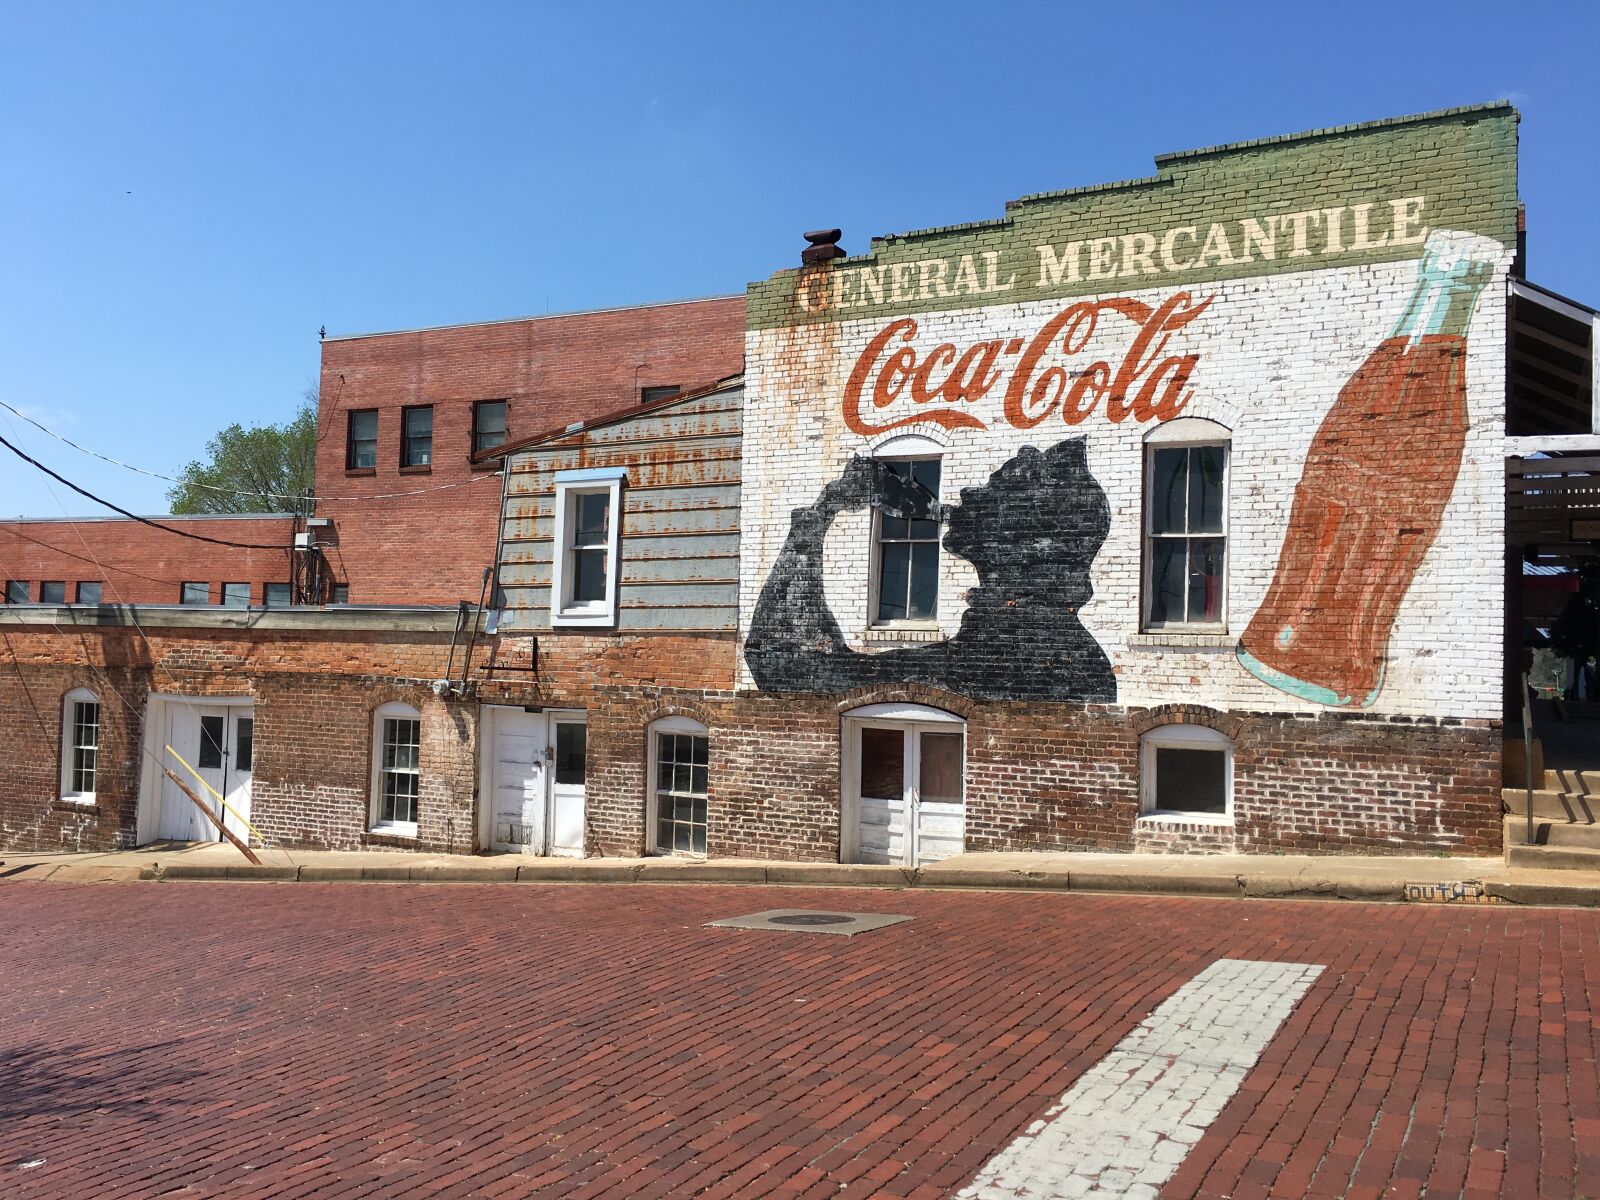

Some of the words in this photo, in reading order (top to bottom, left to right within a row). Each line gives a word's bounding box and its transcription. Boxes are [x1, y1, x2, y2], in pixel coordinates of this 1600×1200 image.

[798, 250, 1016, 312] GENERAL
[1036, 196, 1429, 287] MERCANTILE
[842, 291, 1217, 436] Coca-Cola
